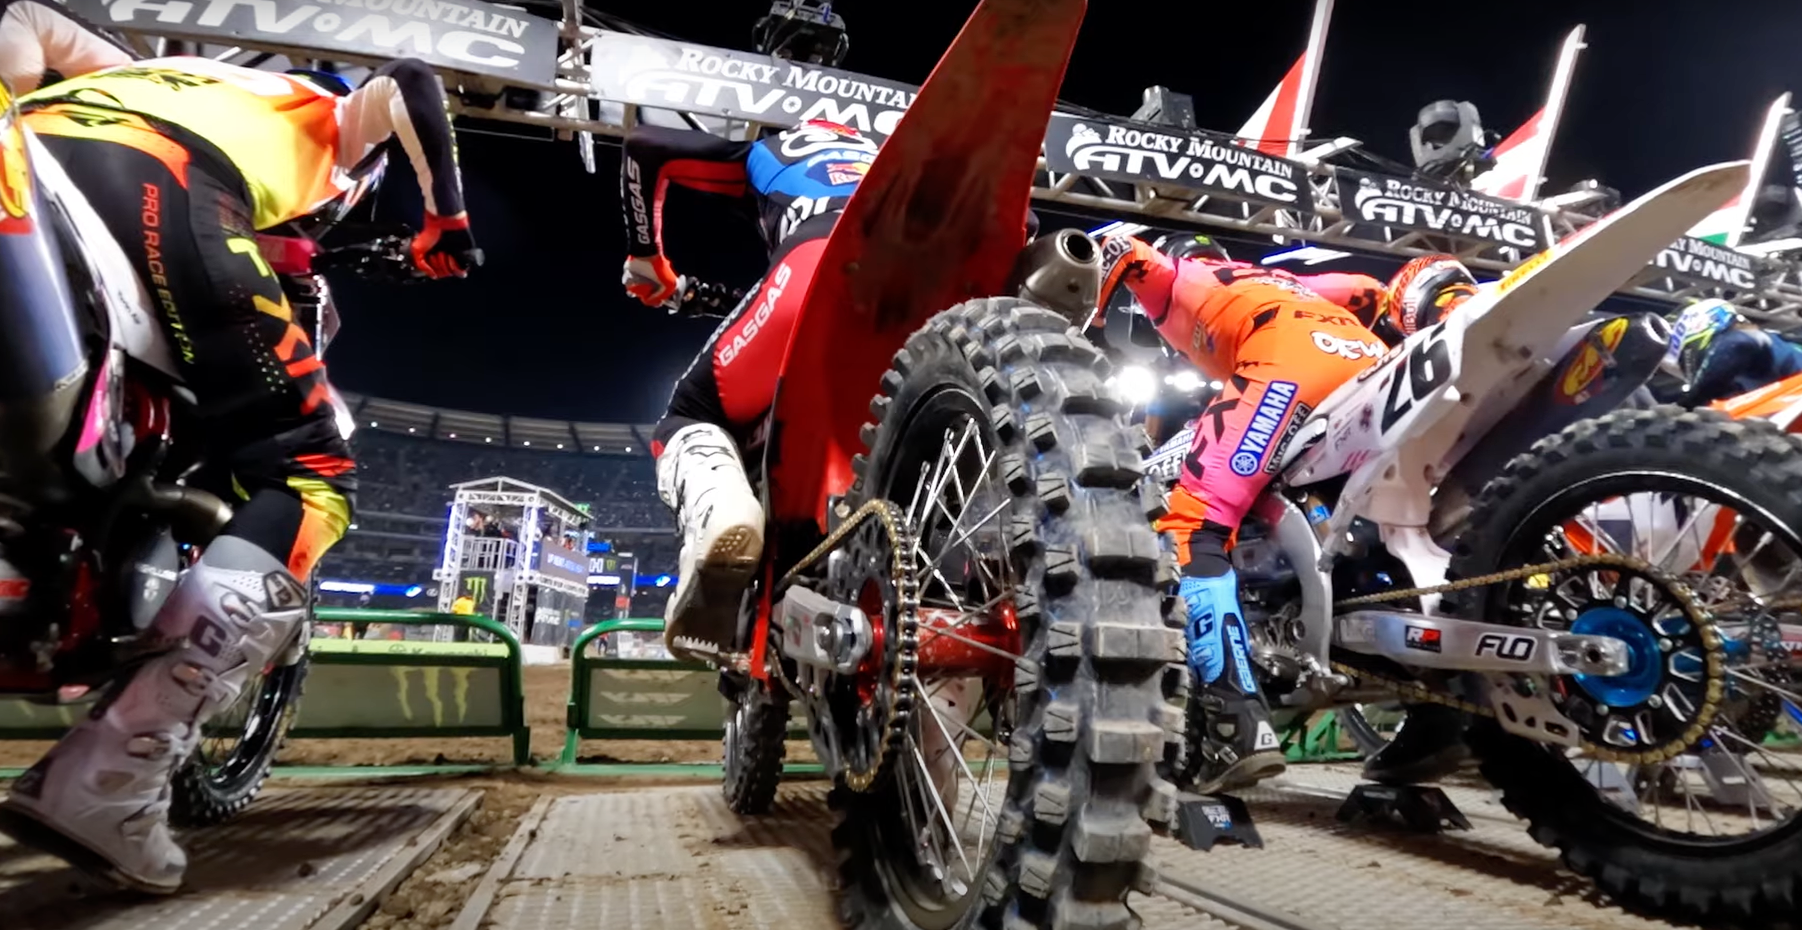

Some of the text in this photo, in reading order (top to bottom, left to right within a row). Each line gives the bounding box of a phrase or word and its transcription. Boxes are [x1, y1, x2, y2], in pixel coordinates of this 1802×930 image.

[676, 47, 918, 111] ROCKY MOUNTAI
[1106, 124, 1293, 179] ROCKY MOUNTAIN
[142, 182, 160, 228] PRO
[626, 155, 651, 245] GASGAS
[1384, 178, 1533, 225] ROCKY MOUNTAIN
[143, 229, 168, 287] RACE
[1688, 238, 1750, 269] MOUNTAIN
[718, 262, 793, 368] GASGAS
[1294, 310, 1359, 327] FXR
[1381, 323, 1452, 437] 26
[1239, 381, 1296, 454] YAMAHA
[1474, 634, 1536, 662] FLO
